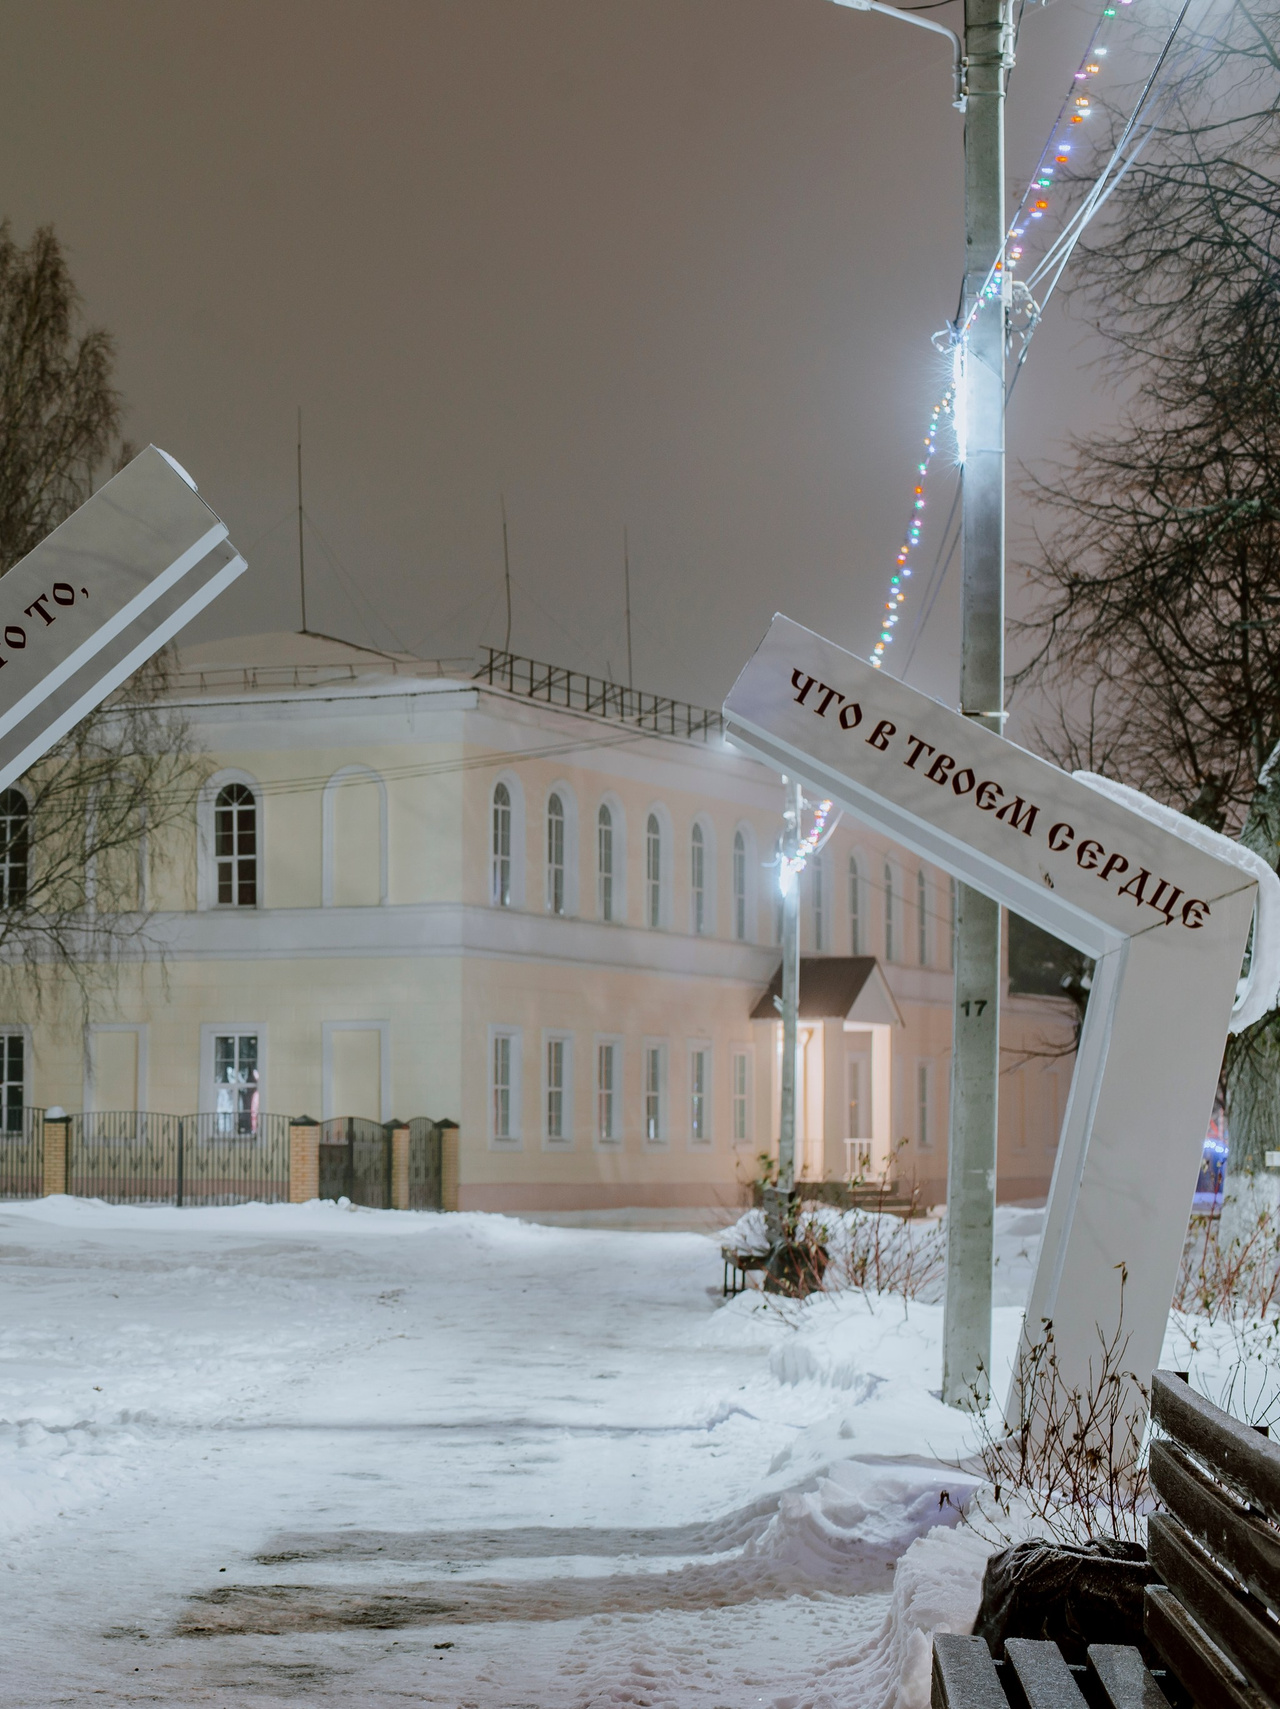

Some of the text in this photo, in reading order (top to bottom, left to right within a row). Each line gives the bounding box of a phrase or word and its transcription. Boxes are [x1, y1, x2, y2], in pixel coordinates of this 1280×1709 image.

[23, 581, 90, 627] ТО,
[790, 667, 863, 731] ЧТО
[864, 719, 898, 752] В
[960, 999, 988, 1018] 17
